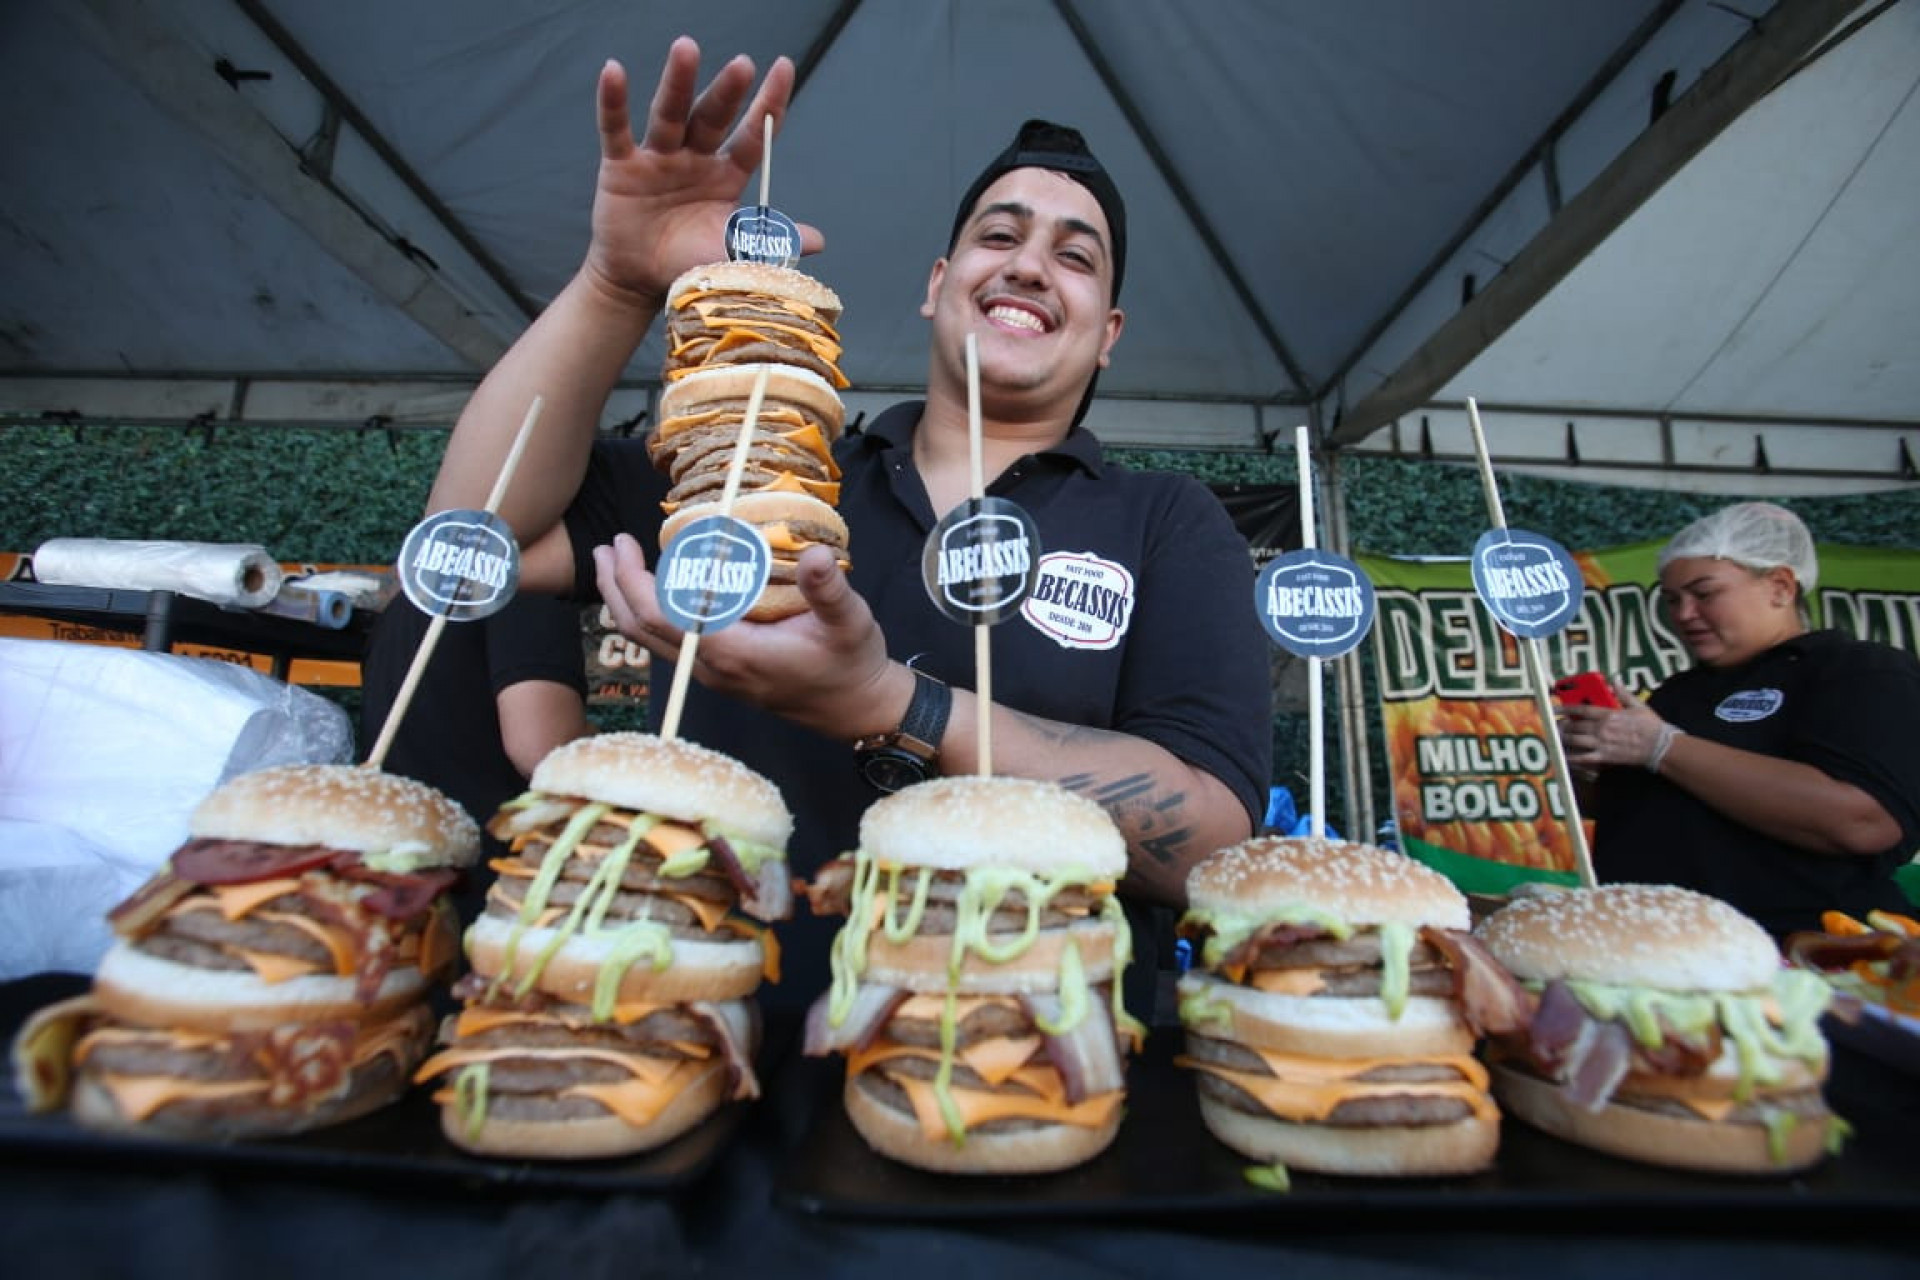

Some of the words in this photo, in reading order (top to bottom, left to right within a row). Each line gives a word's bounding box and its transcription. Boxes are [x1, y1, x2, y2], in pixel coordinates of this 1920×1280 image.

[733, 228, 793, 258] ABECASSIS
[413, 537, 512, 590] ABECASSIS
[664, 556, 758, 595] ABECASSIS
[936, 536, 1031, 587] ABECASSIS
[1034, 573, 1128, 629] BECASSIS
[1266, 586, 1364, 618] ABECASSIS
[1418, 737, 1550, 774] MILHO
[1423, 782, 1539, 820] BOLO
